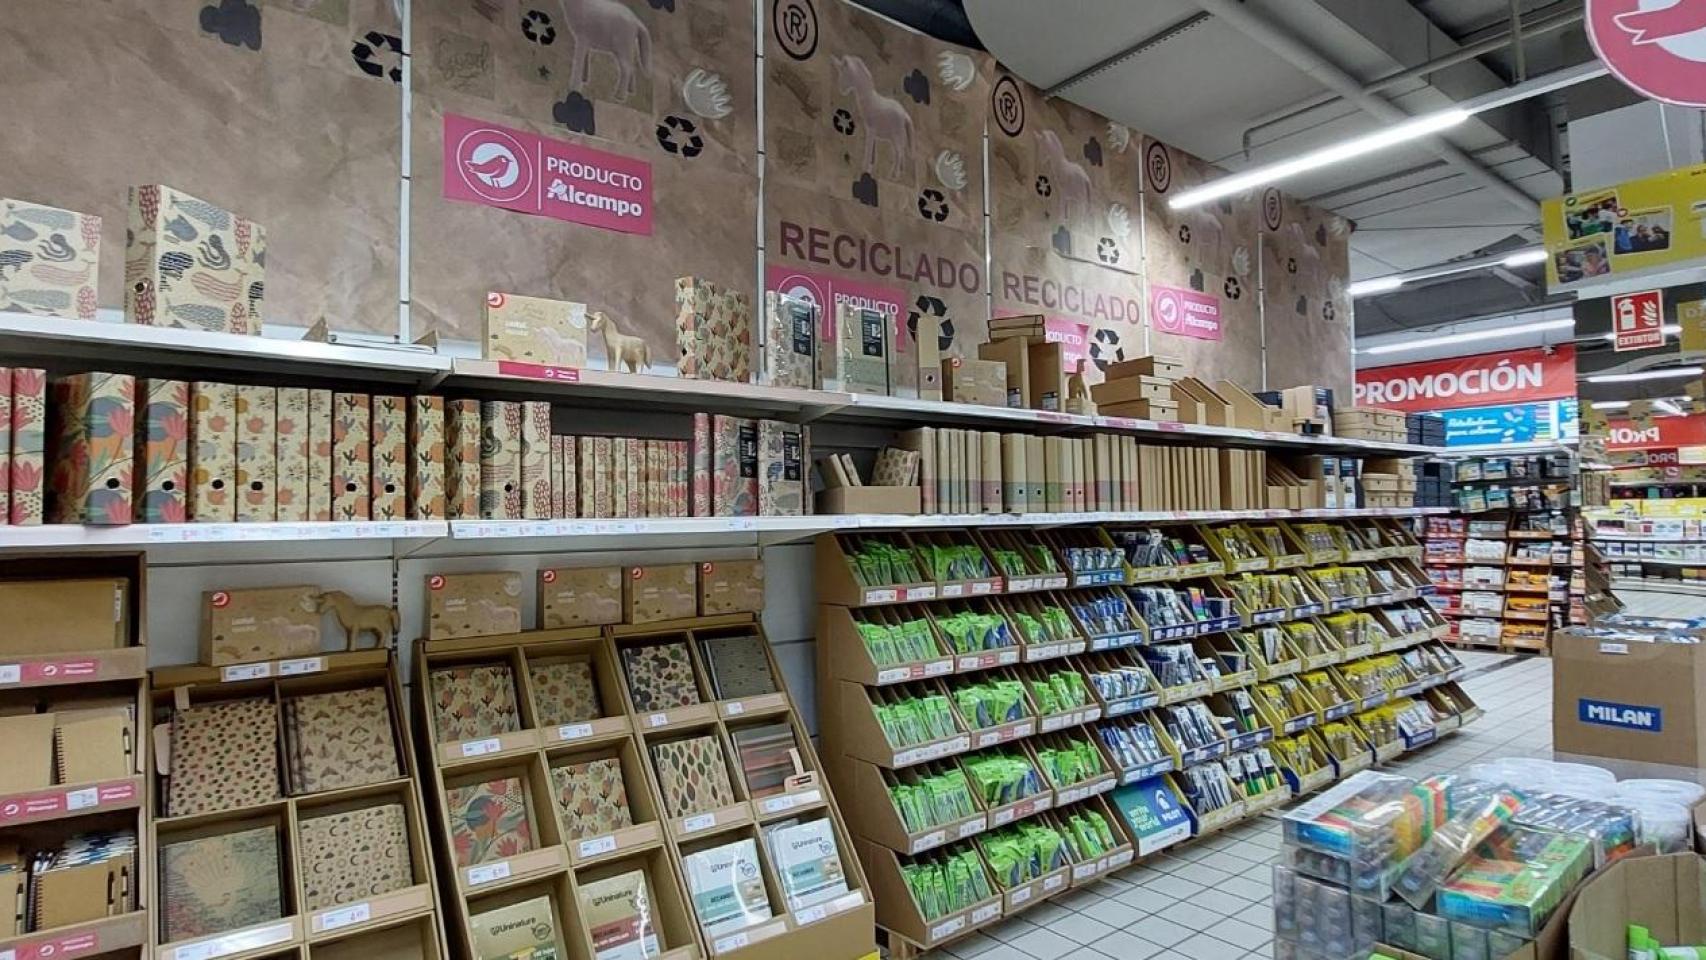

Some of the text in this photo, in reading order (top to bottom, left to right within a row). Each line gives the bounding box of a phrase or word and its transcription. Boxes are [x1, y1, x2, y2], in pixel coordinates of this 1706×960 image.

[547, 156, 642, 191] PRODUCTO
[547, 178, 642, 217] Alcampo
[780, 221, 980, 294] RECICLADO
[1003, 271, 1139, 325] RECICLADO
[1355, 359, 1543, 404] PROMOCIÓN
[1588, 704, 1652, 726] MILAN
